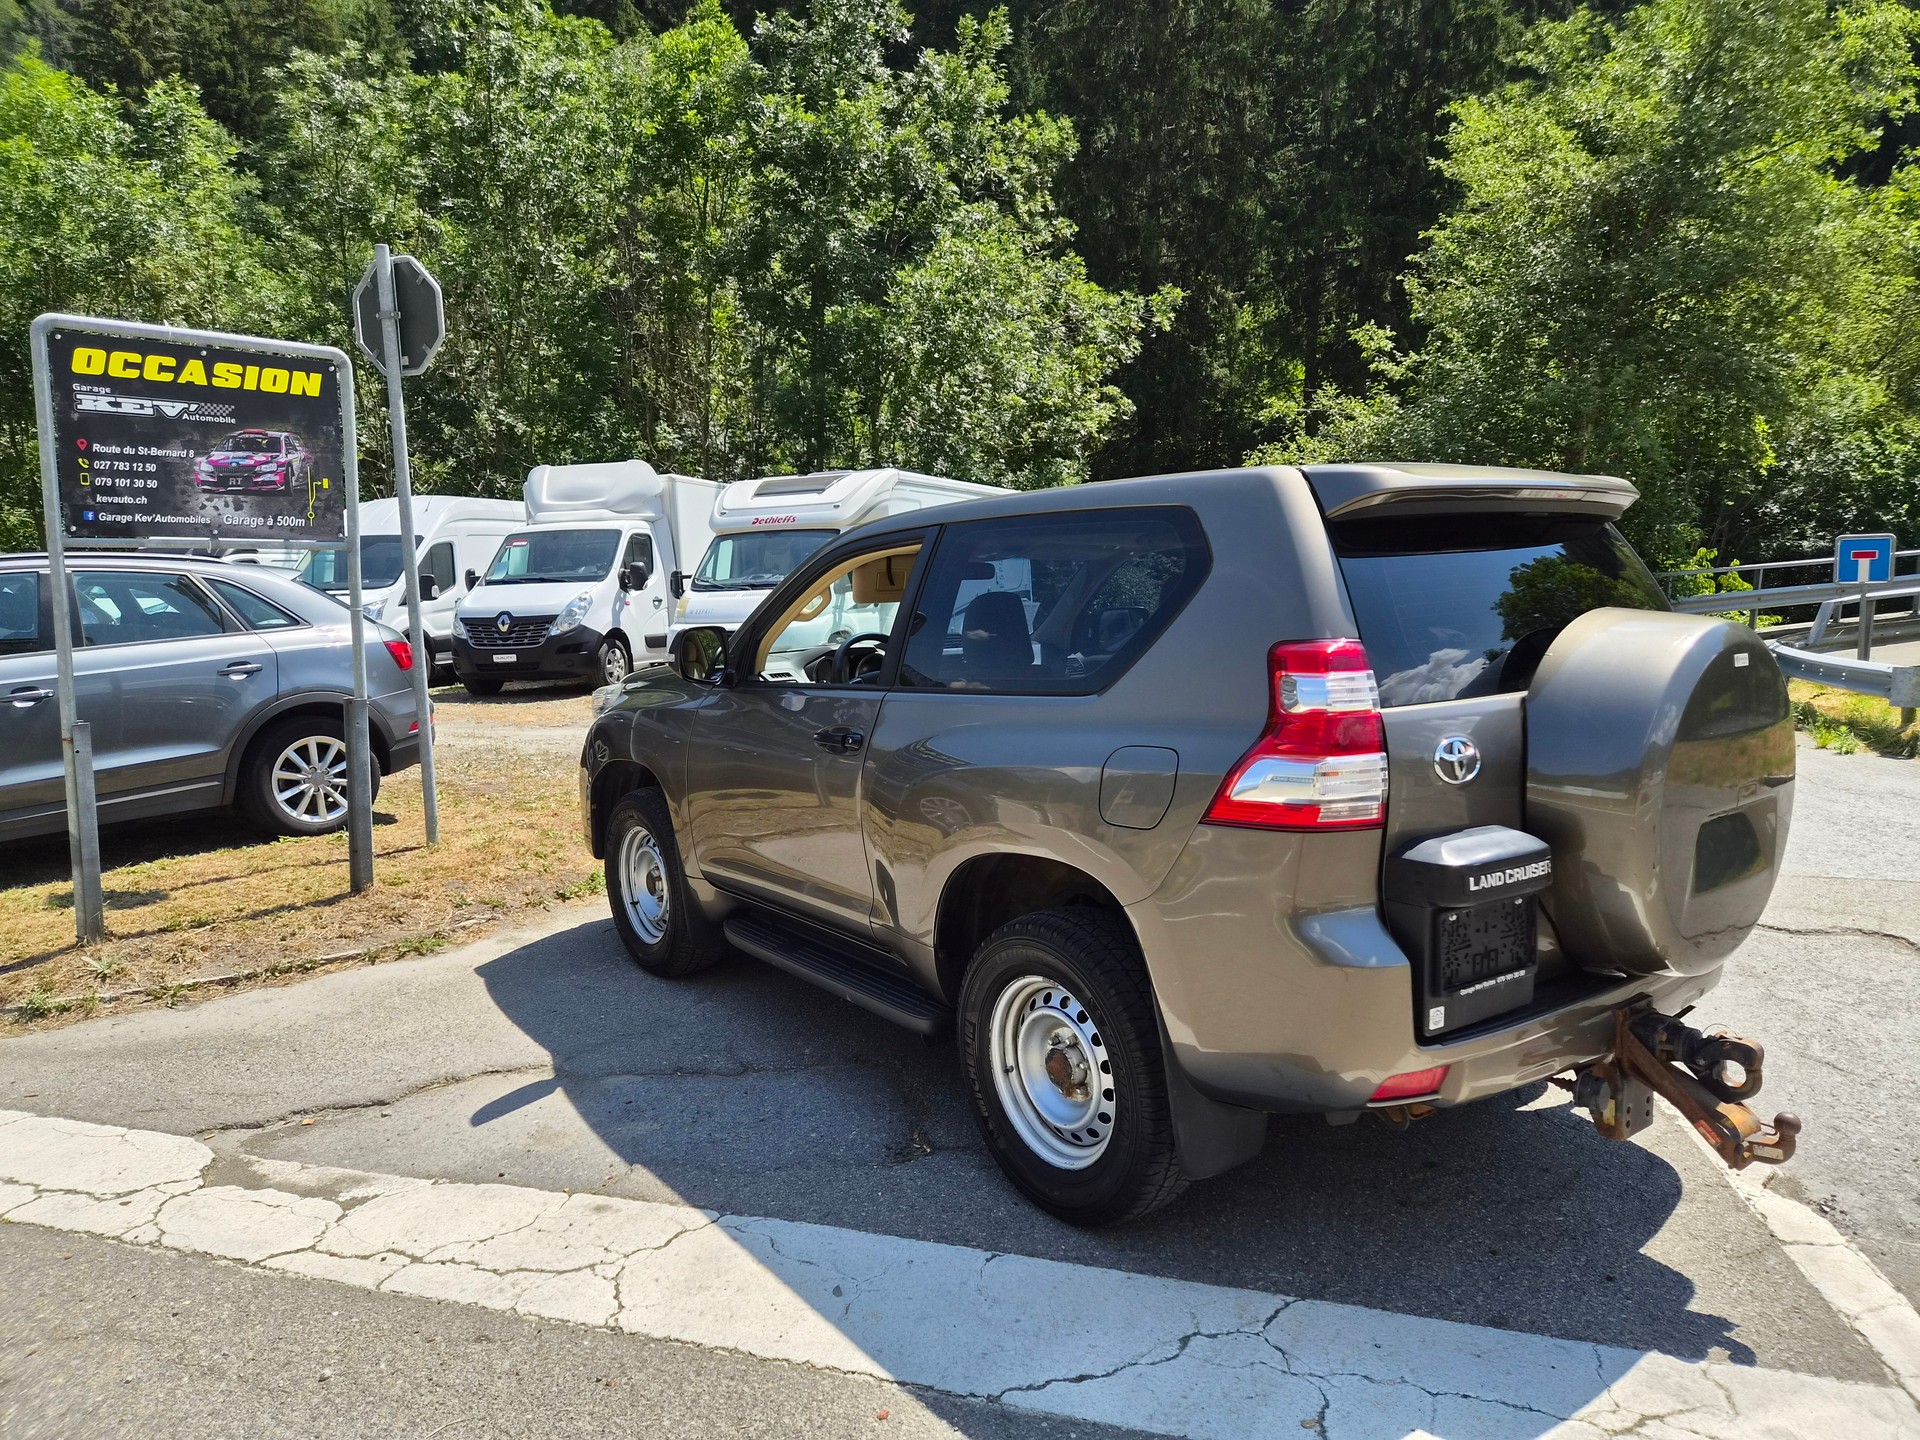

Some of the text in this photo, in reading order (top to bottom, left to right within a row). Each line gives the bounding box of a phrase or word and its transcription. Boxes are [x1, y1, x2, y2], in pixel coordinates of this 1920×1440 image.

[70, 347, 322, 397] OCCASION
[72, 382, 112, 394] Garage
[182, 413, 236, 424] Automobile
[92, 444, 195, 458] Route du St-Bernard 8
[94, 461, 156, 472] 027 783 12 50
[95, 478, 158, 489] 079 101 30 50
[96, 494, 148, 505] kevauto.ch
[98, 512, 132, 523] Garage
[223, 515, 305, 527] Garage à 500m
[752, 515, 797, 525] Dethleffs
[1469, 860, 1552, 892] LAND CRUISER
